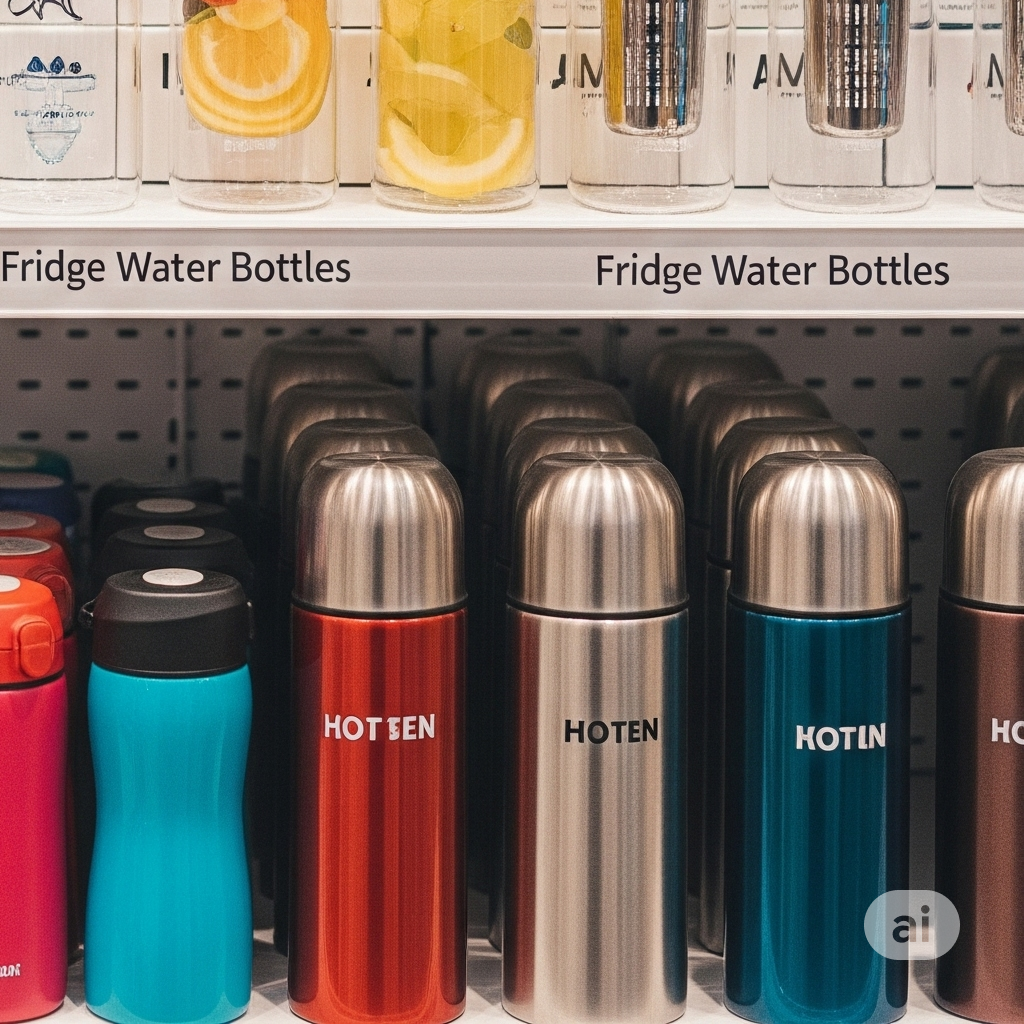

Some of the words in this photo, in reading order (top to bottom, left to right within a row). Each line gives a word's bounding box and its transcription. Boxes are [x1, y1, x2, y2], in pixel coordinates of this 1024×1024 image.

[2, 249, 106, 291] Fridge
[116, 251, 221, 283] Water
[231, 249, 351, 283] Bottles
[597, 252, 702, 295] Fridge
[711, 254, 817, 286] Water
[829, 252, 950, 286] Bottles
[563, 716, 660, 746] HOTEN
